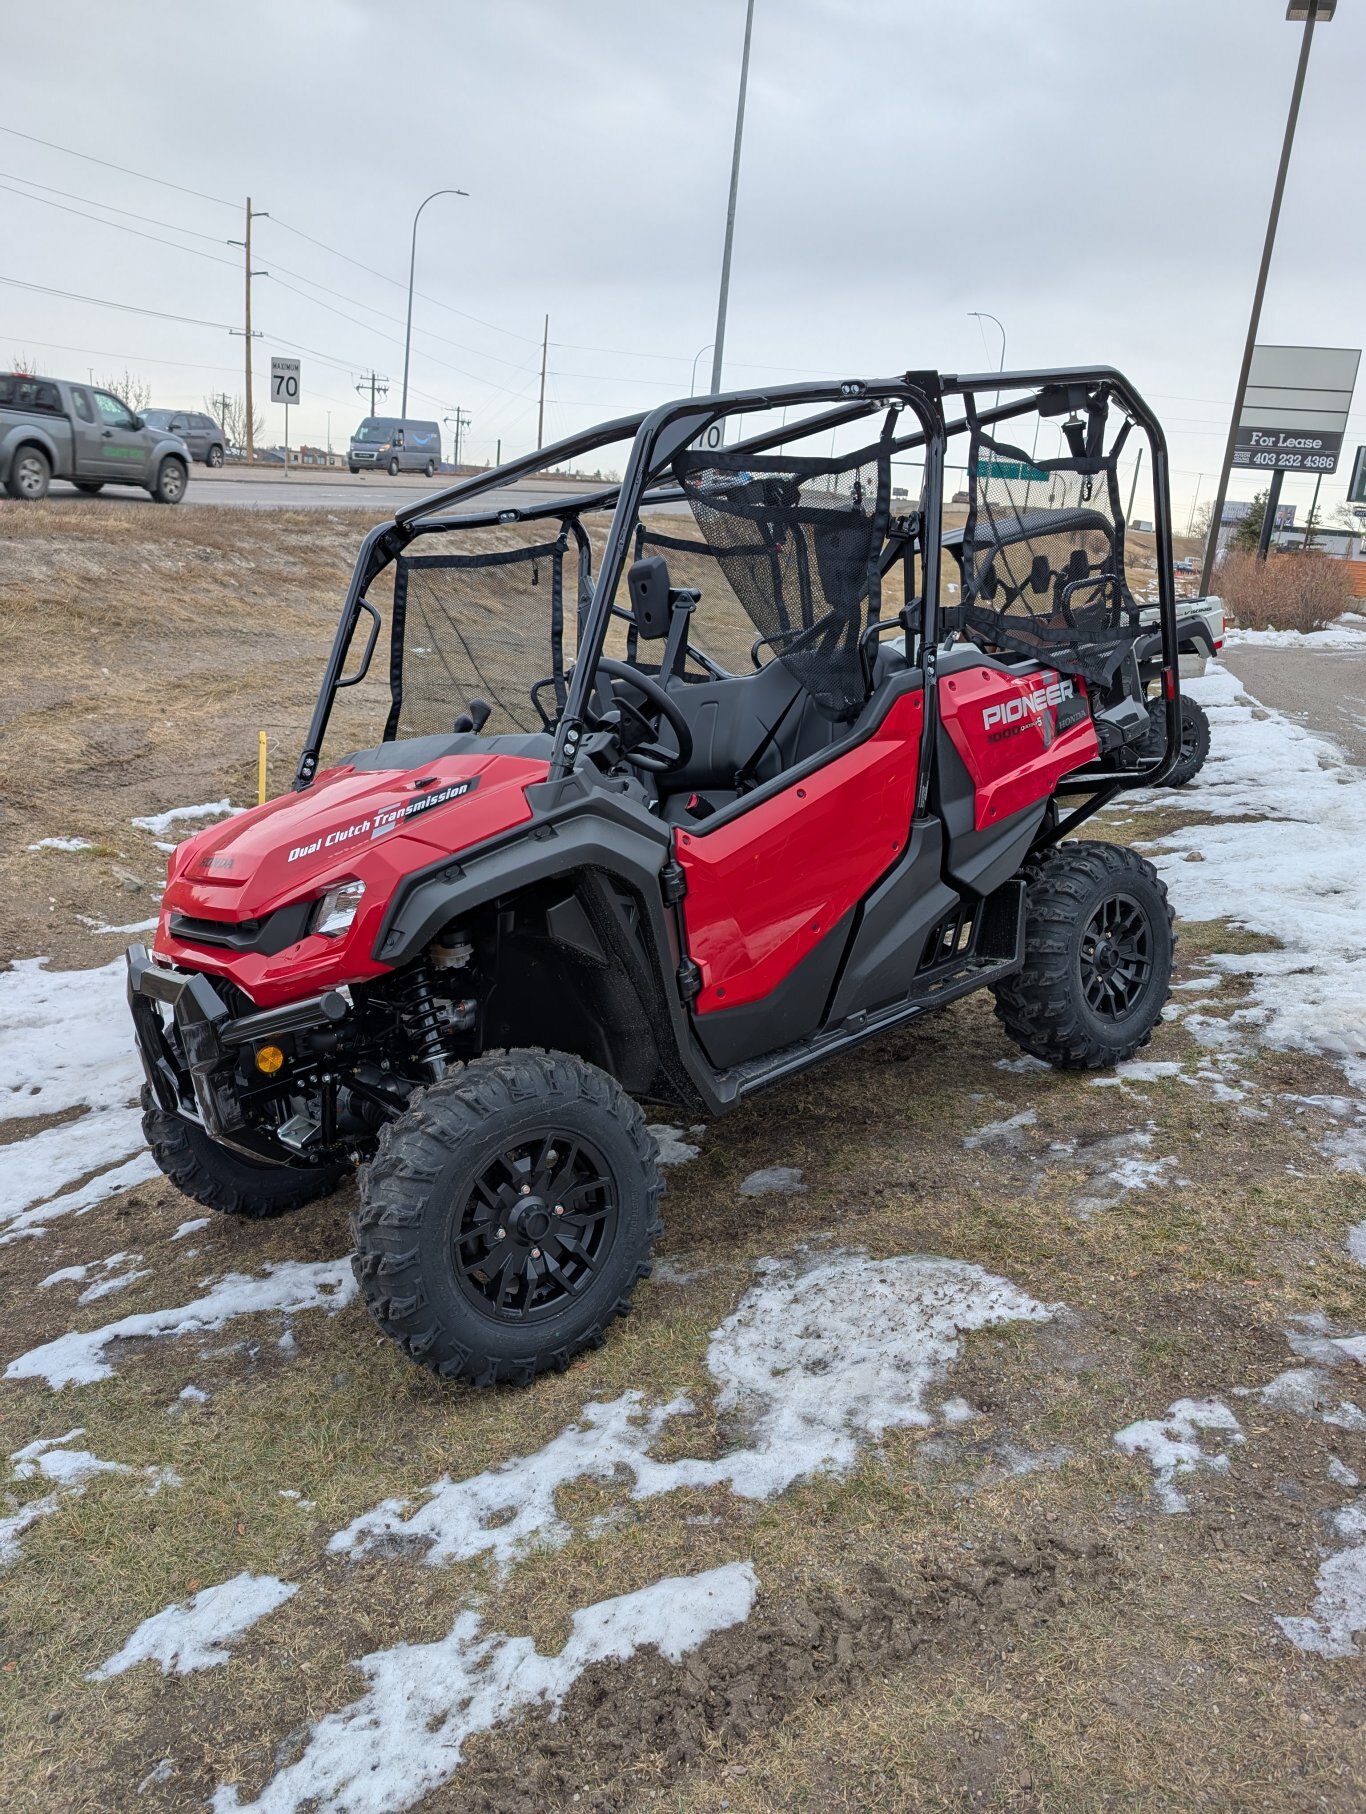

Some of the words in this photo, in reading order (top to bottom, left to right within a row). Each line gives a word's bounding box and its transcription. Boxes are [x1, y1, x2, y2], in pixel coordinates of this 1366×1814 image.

[272, 362, 299, 371] MAXIMUM
[273, 375, 298, 397] 70
[1250, 432, 1276, 447] For
[1277, 433, 1323, 449] Lease
[1253, 453, 1276, 465] 403
[1278, 454, 1302, 467] 232
[1304, 455, 1335, 469] 4386
[982, 679, 1074, 731] PIONEER
[1059, 709, 1087, 730] HONDA
[987, 725, 1021, 744] 1000
[287, 838, 322, 863] Dual
[324, 819, 371, 847] Clutch
[374, 783, 468, 828] Transmission
